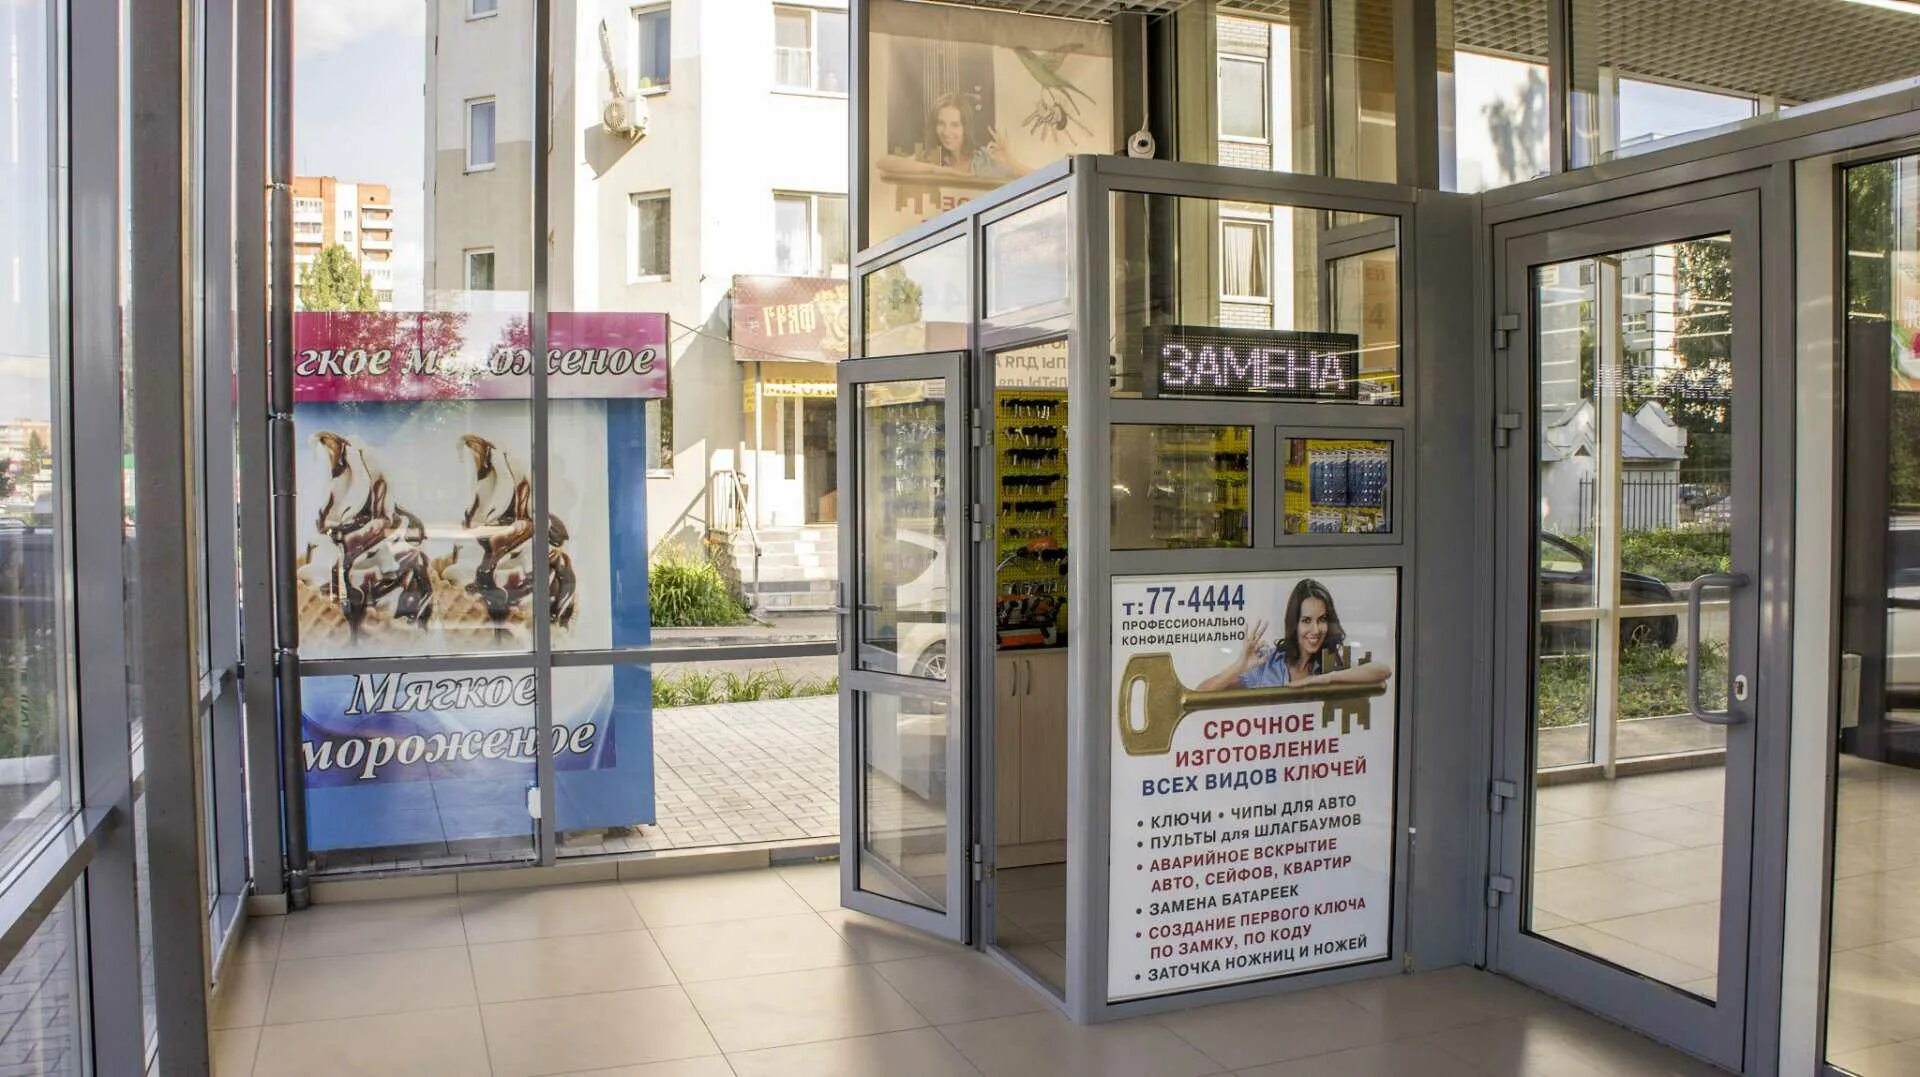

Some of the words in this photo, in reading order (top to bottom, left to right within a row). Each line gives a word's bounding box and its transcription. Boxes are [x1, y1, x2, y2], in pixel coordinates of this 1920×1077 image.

[296, 347, 392, 377] гкое
[402, 346, 656, 386] моженое
[1162, 344, 1345, 390] ЗАМЕНА
[1122, 616, 1245, 631] ПРОФЕССИОНАЛЬНО
[1122, 631, 1245, 646] КОНФИДЕНЦИАЛЬНО
[344, 672, 537, 715] Мягкое
[1203, 713, 1315, 740] СРОЧНОЕ
[302, 721, 596, 779] мороженое
[1175, 738, 1340, 768] ИЗГОТОВЛЕНИЕ
[1142, 775, 1198, 796] ВСЕХ
[1205, 768, 1277, 790] ВИДОВ
[1284, 756, 1367, 782] КЛЮЧЕЙ
[1151, 810, 1212, 829] КЛЮЧИ
[1231, 803, 1277, 819] ЧИПЫ
[1281, 799, 1313, 817] ДЛЯ
[1318, 794, 1357, 812] АВТО
[1150, 830, 1216, 849] ПУЛЬТЫ
[1221, 829, 1249, 844] для
[1254, 813, 1362, 837] ШЛАГБАУМОВ
[1150, 847, 1249, 872] АВАРИЙНОЕ
[1254, 838, 1338, 859] ВСКРЫТИЕ
[1151, 875, 1200, 892] АВТО,
[1205, 865, 1278, 885] СЕЙФОВ,
[1283, 855, 1352, 875] КВАРТИР
[1149, 895, 1217, 916] ЗАМЕНА
[1222, 884, 1299, 906] БАТАРЕЕК
[1148, 916, 1236, 940] СОЗДАНИЕ
[1240, 906, 1310, 927] ПЕРВОГО
[1314, 897, 1366, 916] КЛЮЧА
[1148, 959, 1221, 982] ЗАТОЧКА
[1225, 948, 1295, 970] НОЖНИЦ
[1299, 945, 1309, 958] И
[1314, 933, 1368, 956] НОЖЕЙ
[1150, 944, 1173, 960] ПО
[1178, 935, 1239, 955] ЗАМКУ,
[1244, 931, 1266, 946] ПО
[1270, 924, 1312, 942] КОДУ
